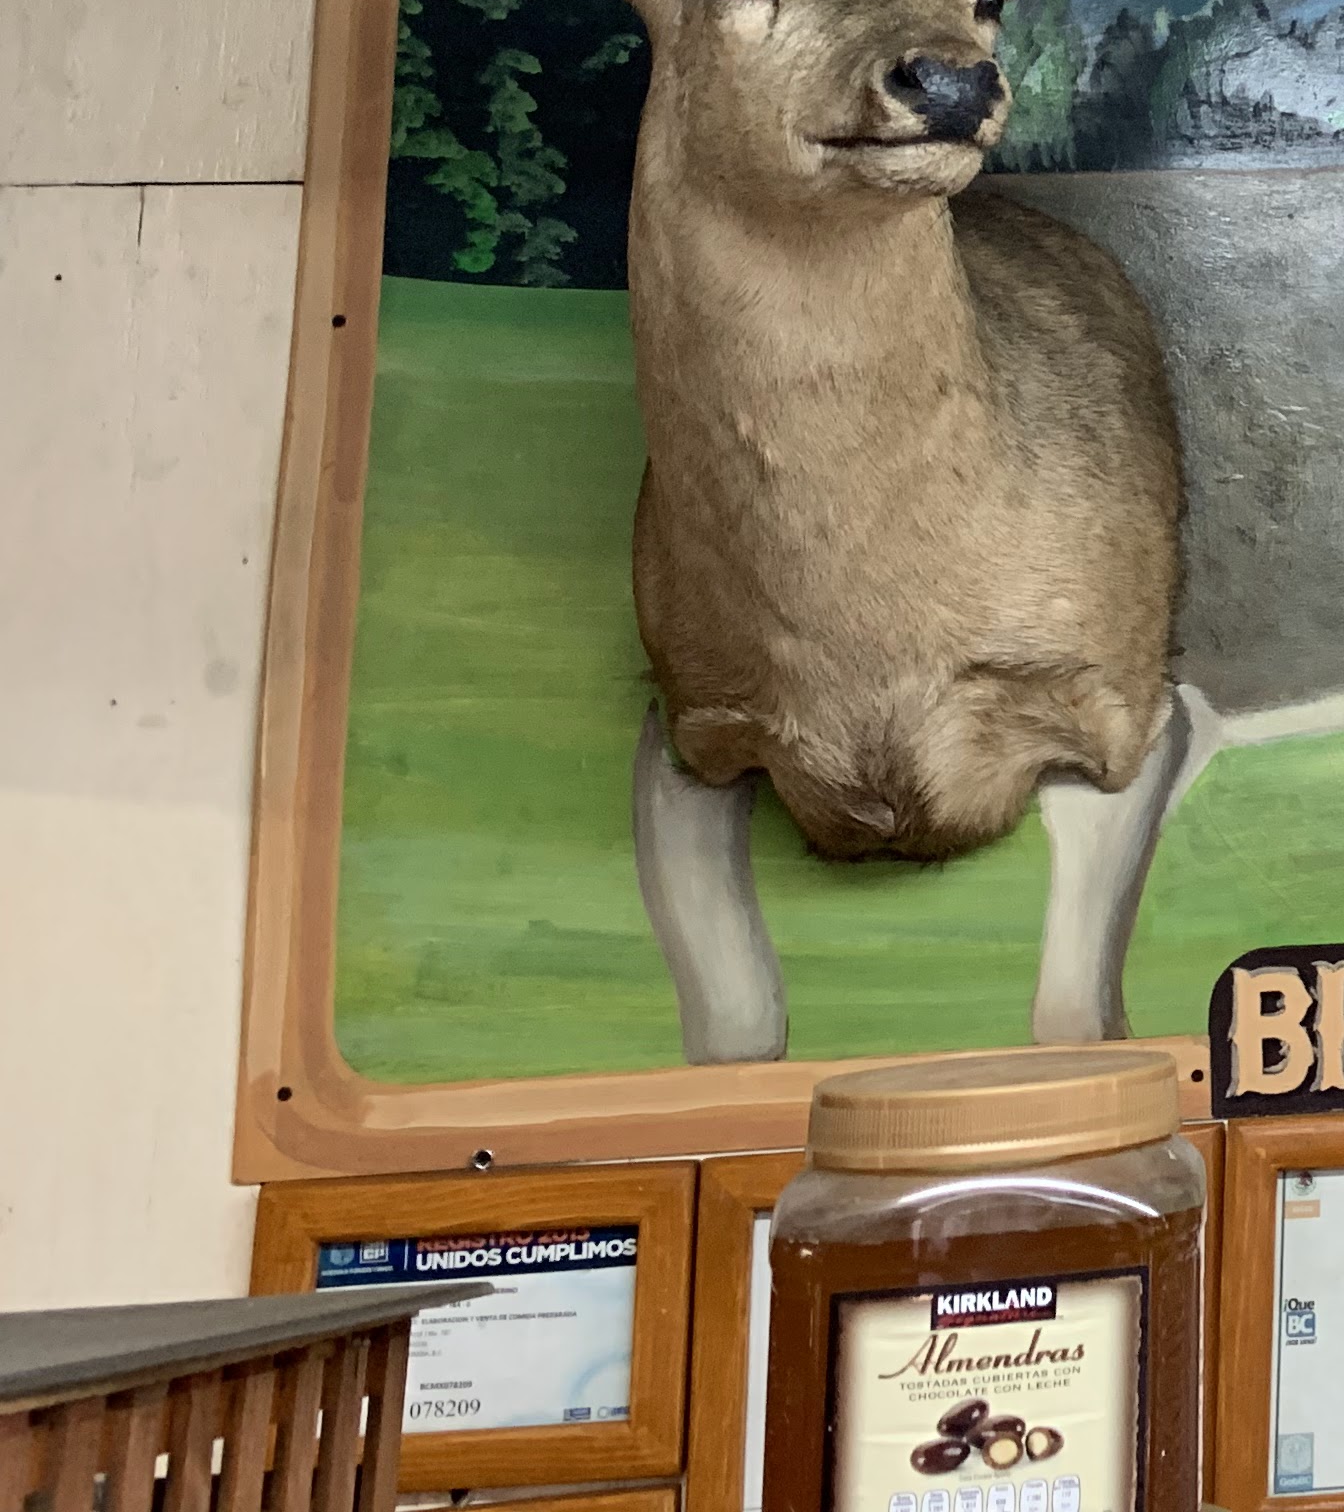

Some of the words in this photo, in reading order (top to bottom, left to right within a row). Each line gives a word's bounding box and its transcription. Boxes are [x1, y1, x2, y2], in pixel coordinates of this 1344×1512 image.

[416, 1246, 502, 1271] UNIDOS
[505, 1237, 637, 1265] CUMPLIMOS
[937, 1286, 1053, 1316] KIRKLAND
[1287, 1315, 1314, 1335] BC
[877, 1326, 1085, 1380] Almendras
[900, 1377, 967, 1391] TOSTADAS
[973, 1370, 1048, 1385] CUBIERTAS
[1054, 1365, 1081, 1377] CON
[909, 1386, 988, 1402] CHOCOLATE
[993, 1383, 1021, 1394] CON
[1027, 1377, 1071, 1391] LECHE
[409, 1398, 481, 1420] 078209
